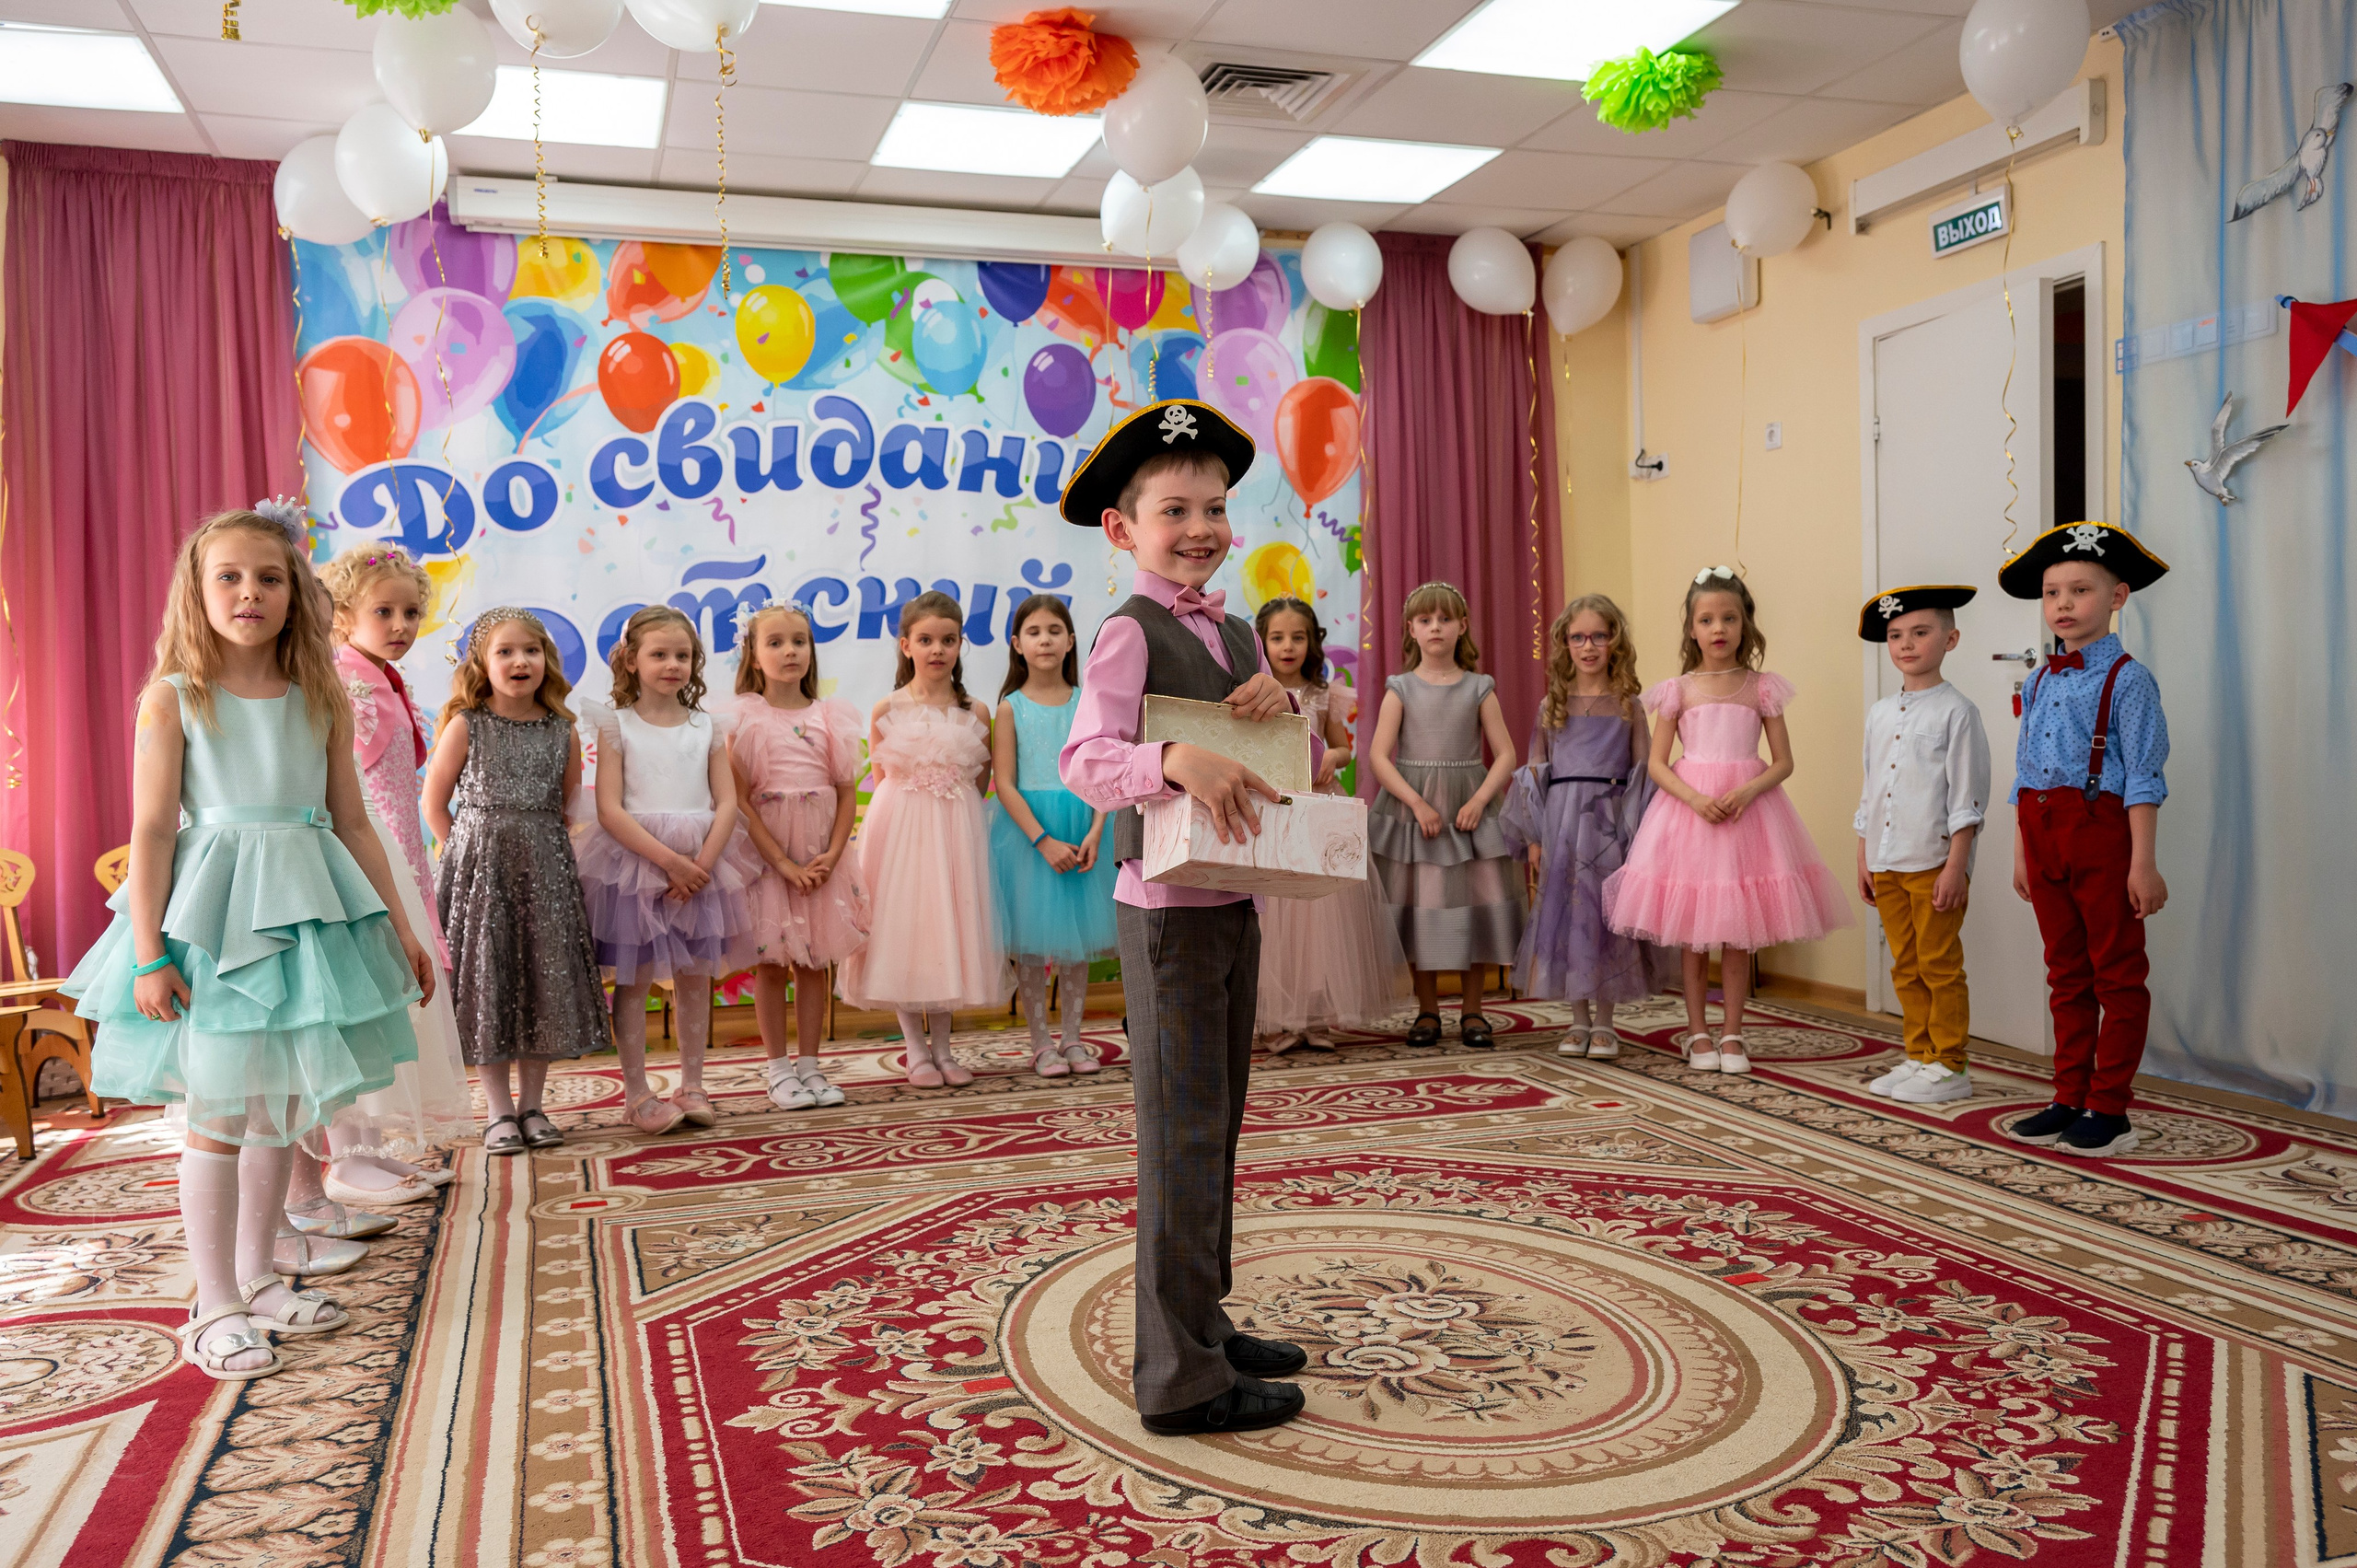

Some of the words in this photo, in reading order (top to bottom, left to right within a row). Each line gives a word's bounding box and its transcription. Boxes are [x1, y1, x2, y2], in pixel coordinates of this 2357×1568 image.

[1937, 205, 2003, 248] ВЫХОД
[339, 460, 559, 562] До
[589, 395, 1094, 509] свидани
[457, 553, 1074, 689] тский
